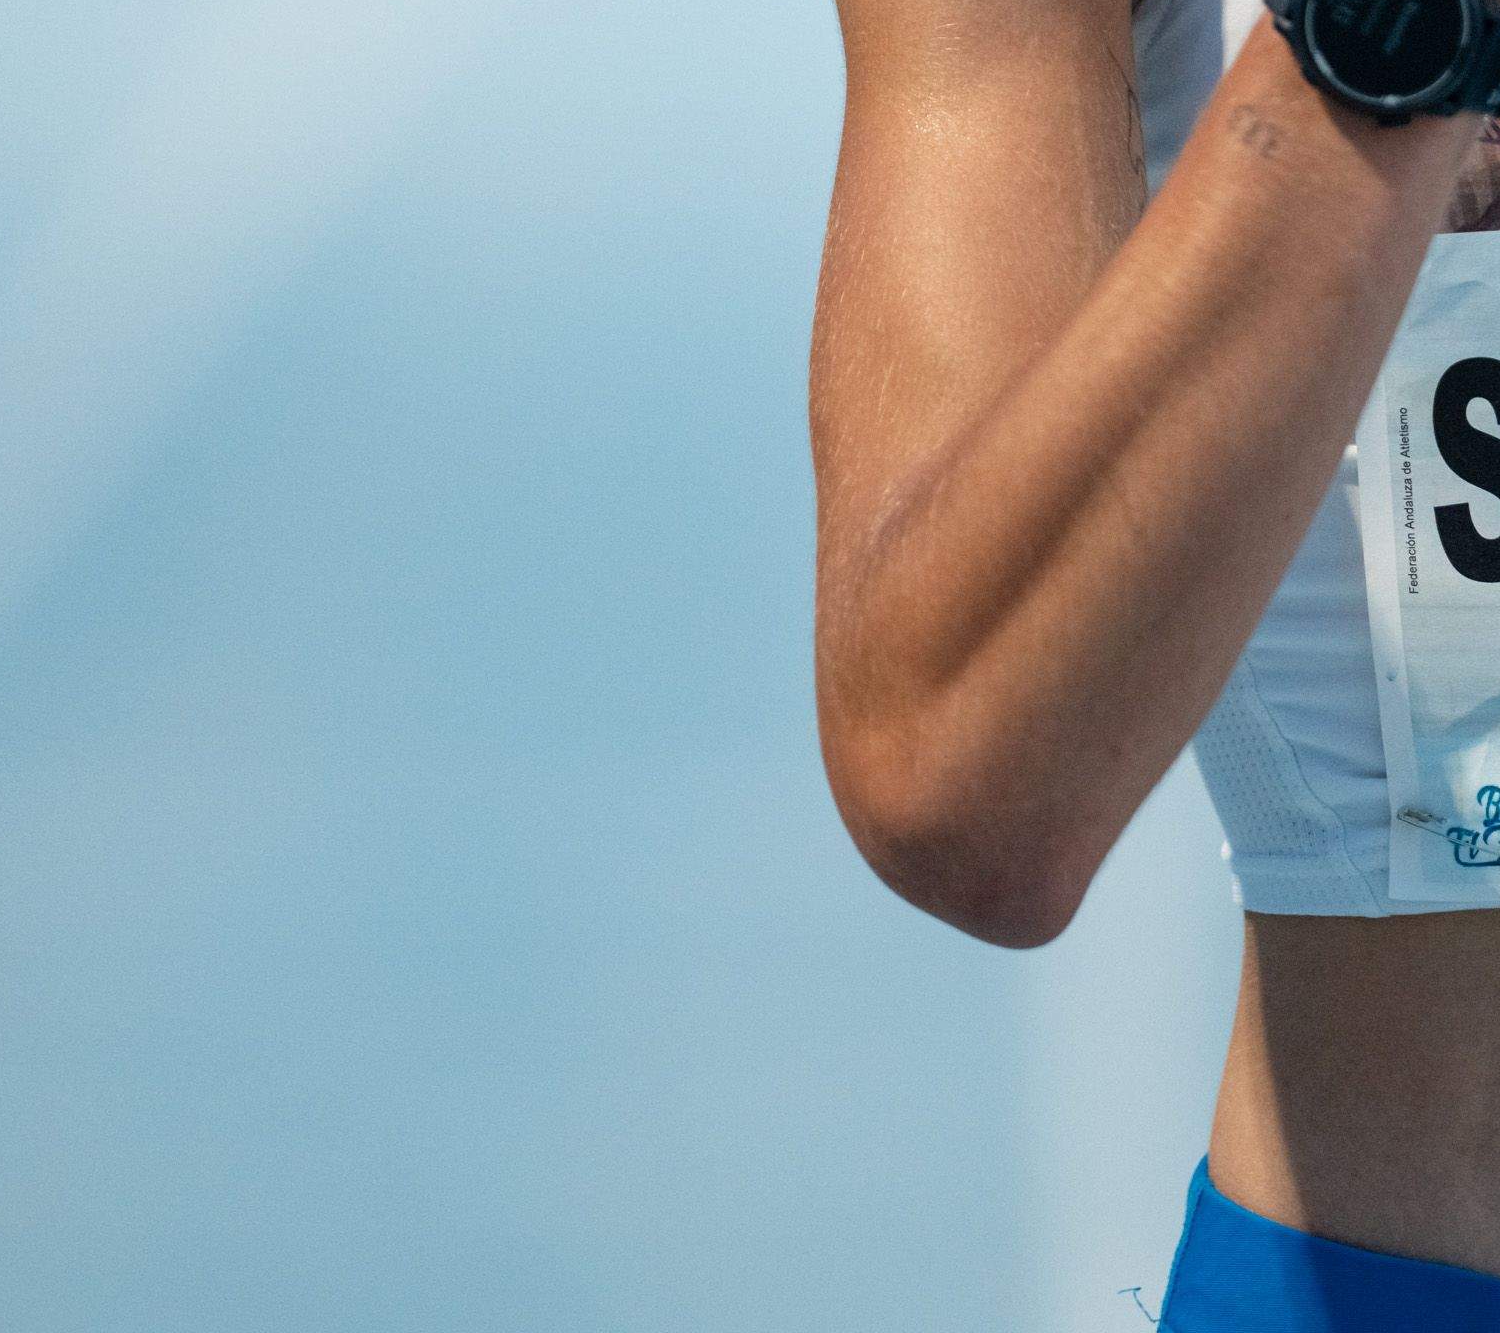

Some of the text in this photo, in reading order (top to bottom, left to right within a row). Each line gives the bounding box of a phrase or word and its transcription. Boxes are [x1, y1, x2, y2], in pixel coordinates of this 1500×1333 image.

[1399, 407, 1419, 595] Federación Andaluza de Atletismo
